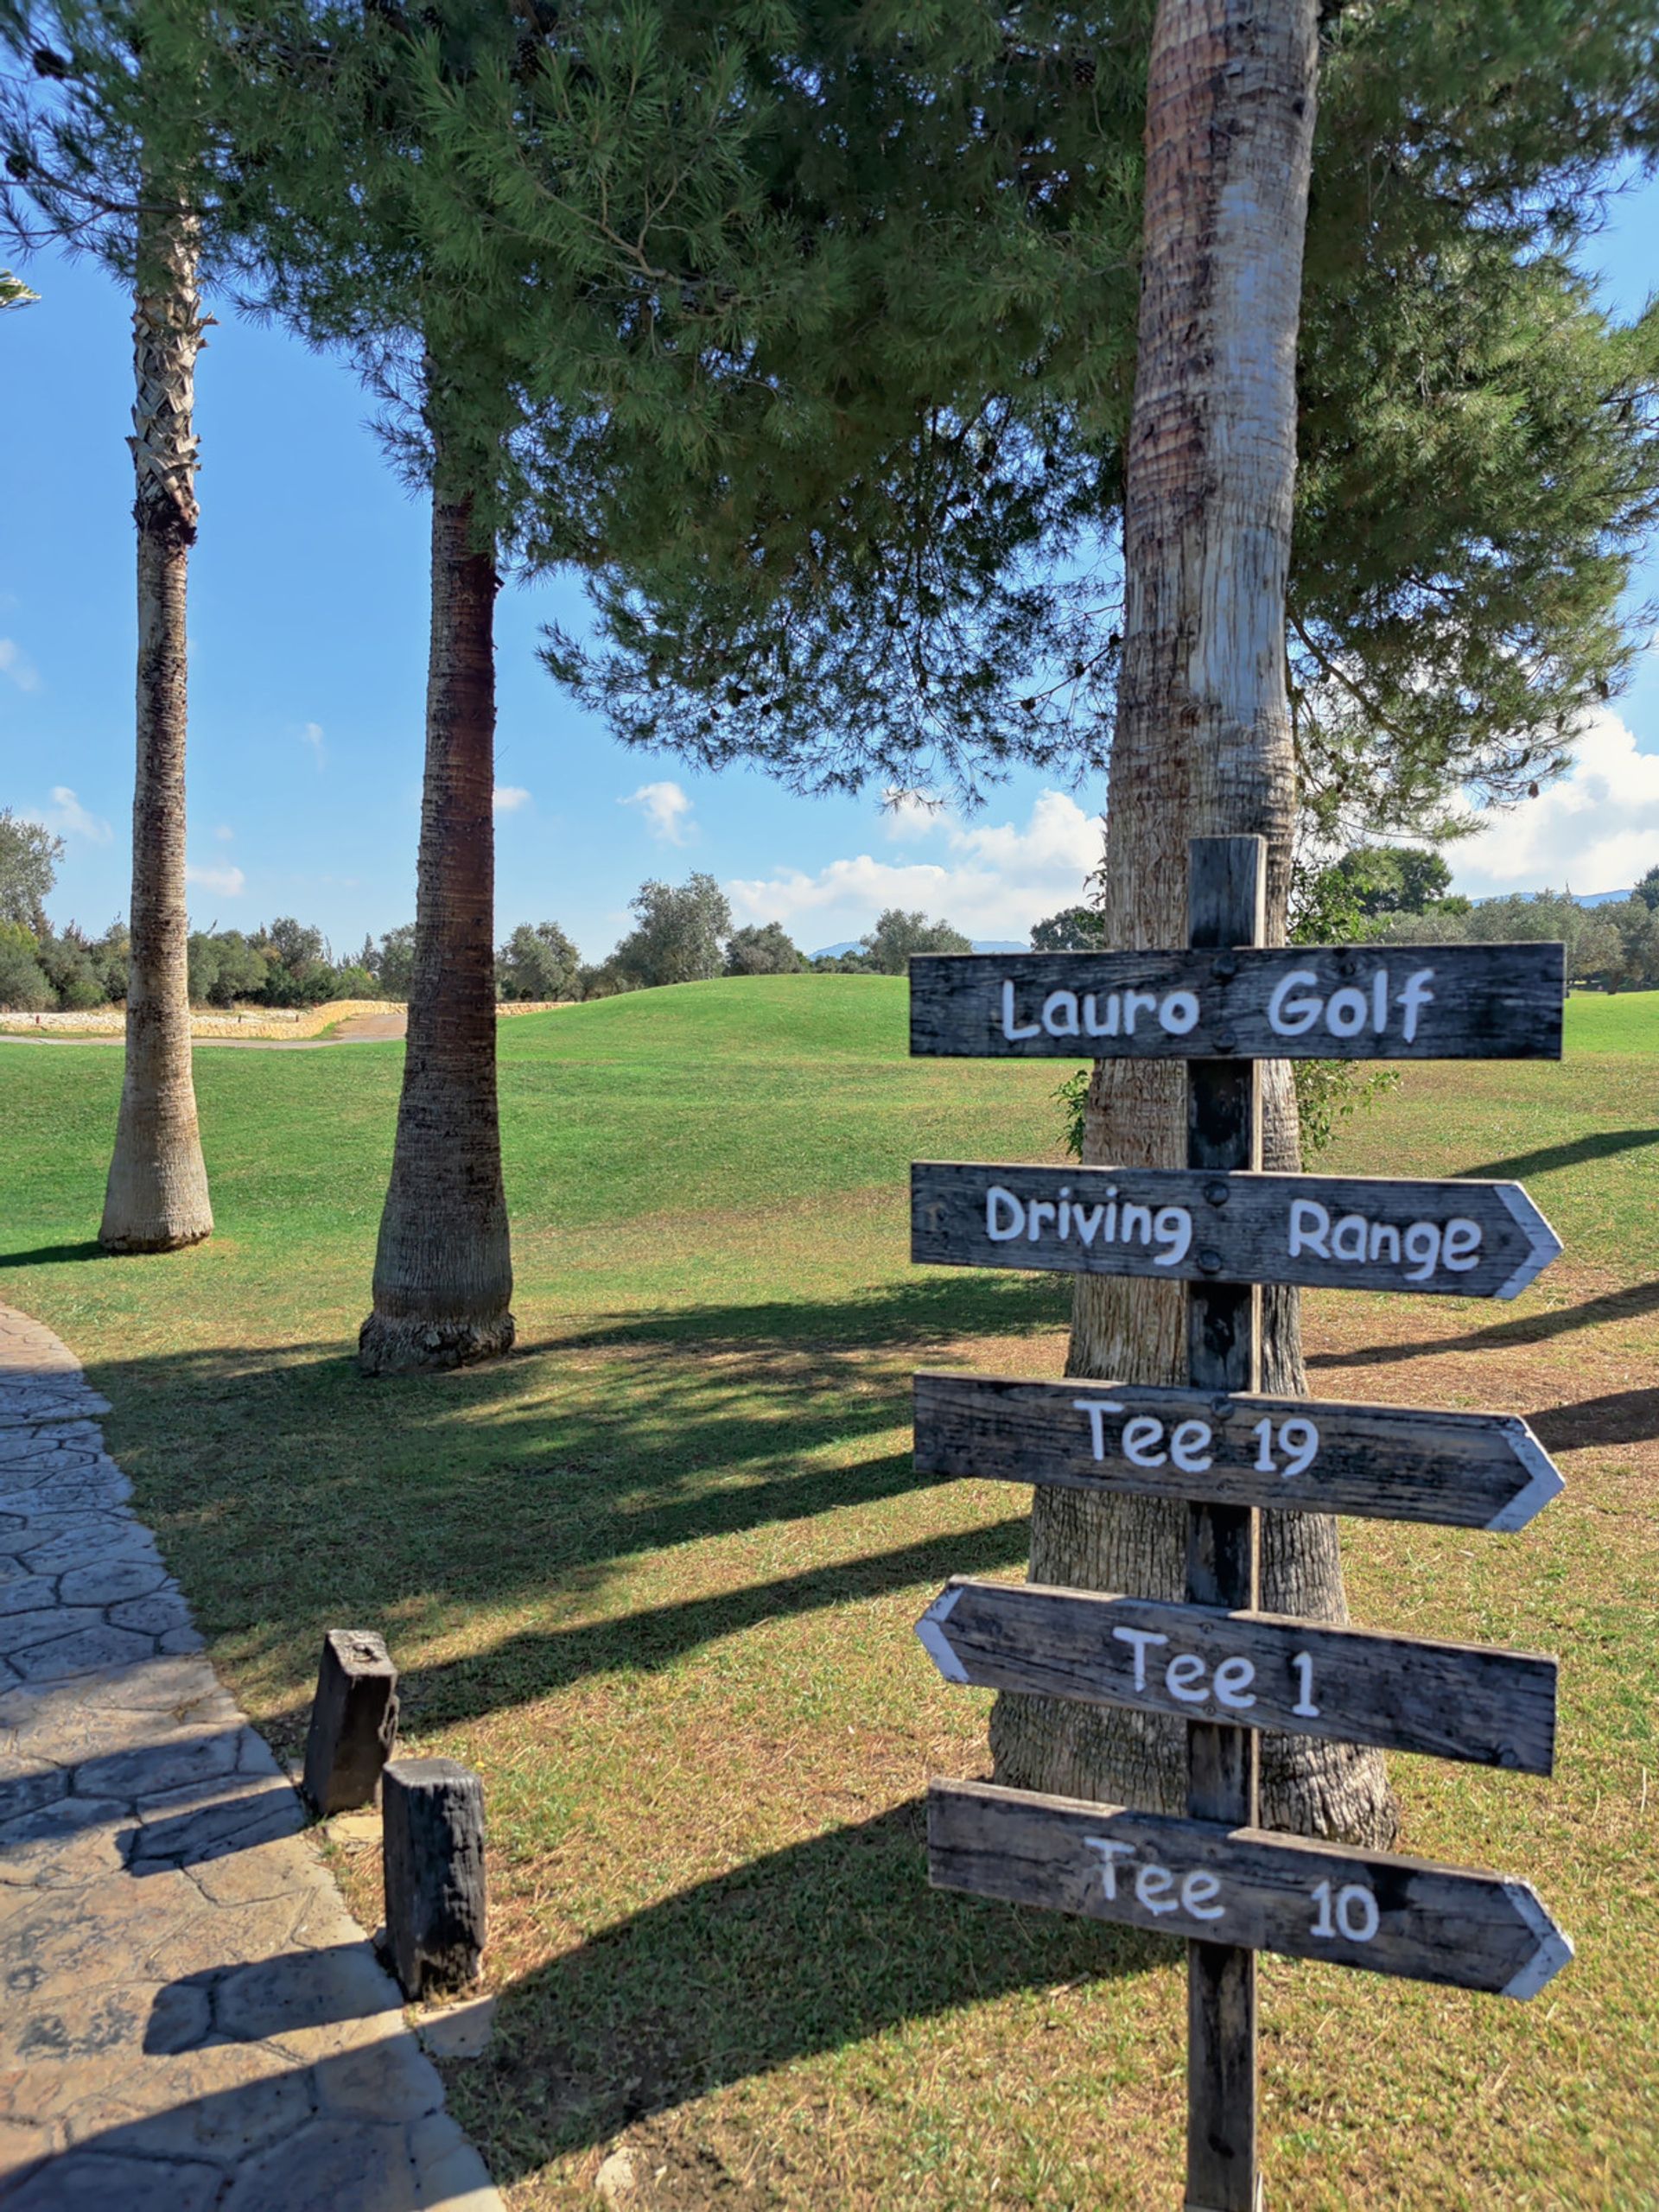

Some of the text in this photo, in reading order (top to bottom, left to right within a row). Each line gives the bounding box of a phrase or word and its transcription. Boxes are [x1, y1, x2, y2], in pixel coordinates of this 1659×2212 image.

[1002, 969, 1434, 1042] Lauro Golf
[985, 1186, 1482, 1280] Driving Range
[1074, 1399, 1319, 1475] Tee 19
[1112, 1627, 1319, 1717] Tee 1
[1084, 1837, 1379, 1941] Tee 10
